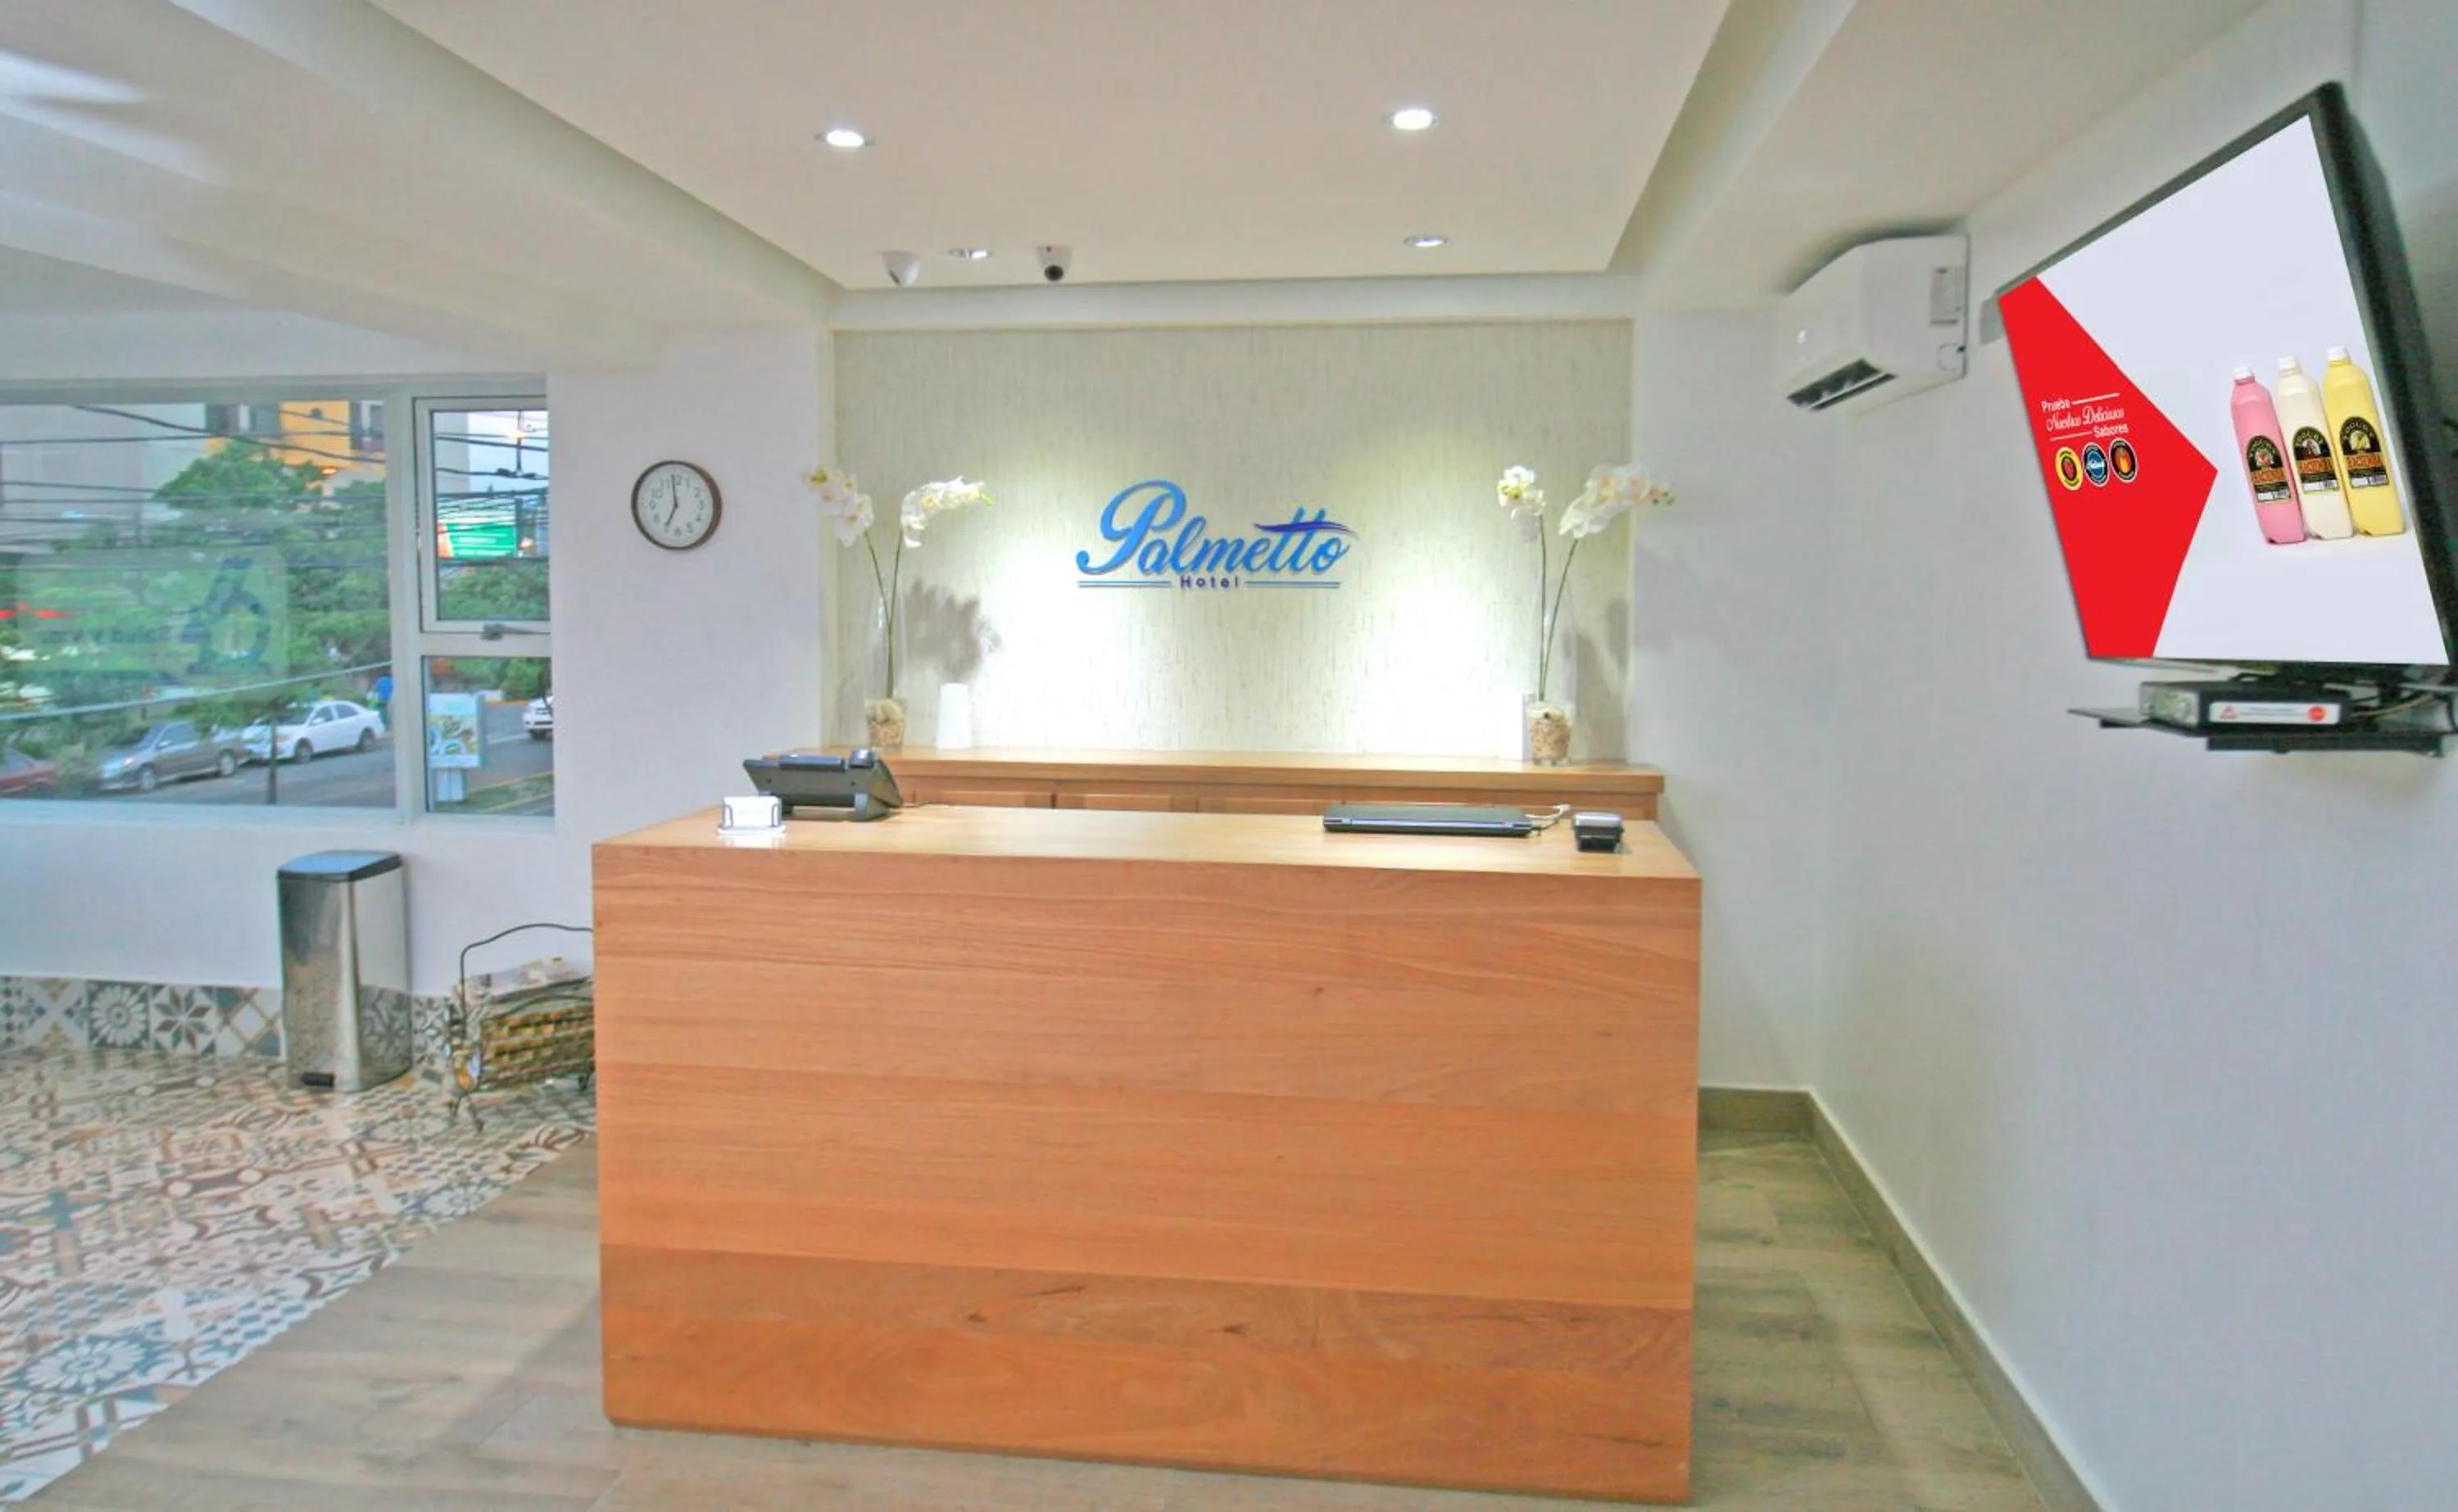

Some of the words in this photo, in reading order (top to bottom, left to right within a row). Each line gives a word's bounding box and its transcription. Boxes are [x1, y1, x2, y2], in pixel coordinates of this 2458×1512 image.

[2041, 398, 2070, 413] Prueba
[2093, 423, 2129, 438] Sabores
[648, 499, 656, 511] 9
[1076, 479, 1359, 576] Palmetto
[1180, 576, 1239, 589] Hotel
